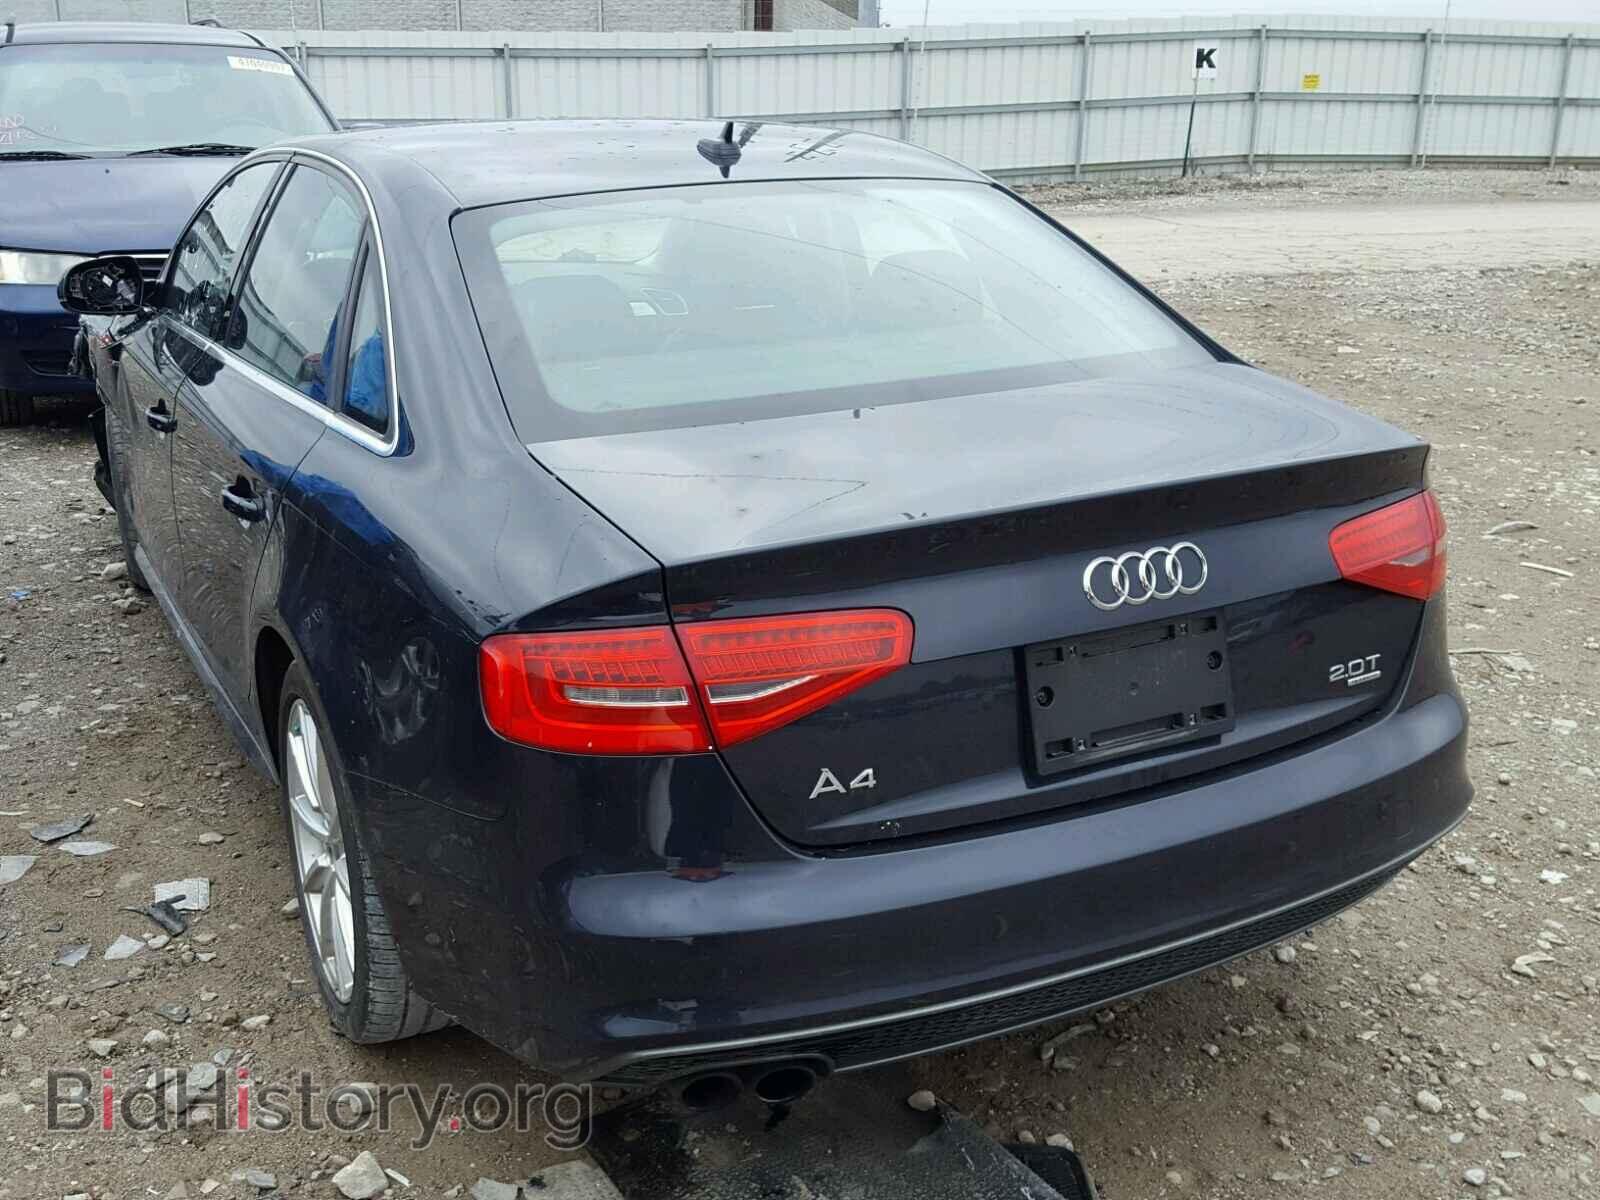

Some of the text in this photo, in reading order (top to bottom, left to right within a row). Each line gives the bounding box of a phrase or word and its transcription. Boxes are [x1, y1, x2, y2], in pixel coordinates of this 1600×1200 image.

[1196, 48, 1217, 68] K
[1329, 653, 1381, 682] 2.0T
[808, 767, 877, 799] A4
